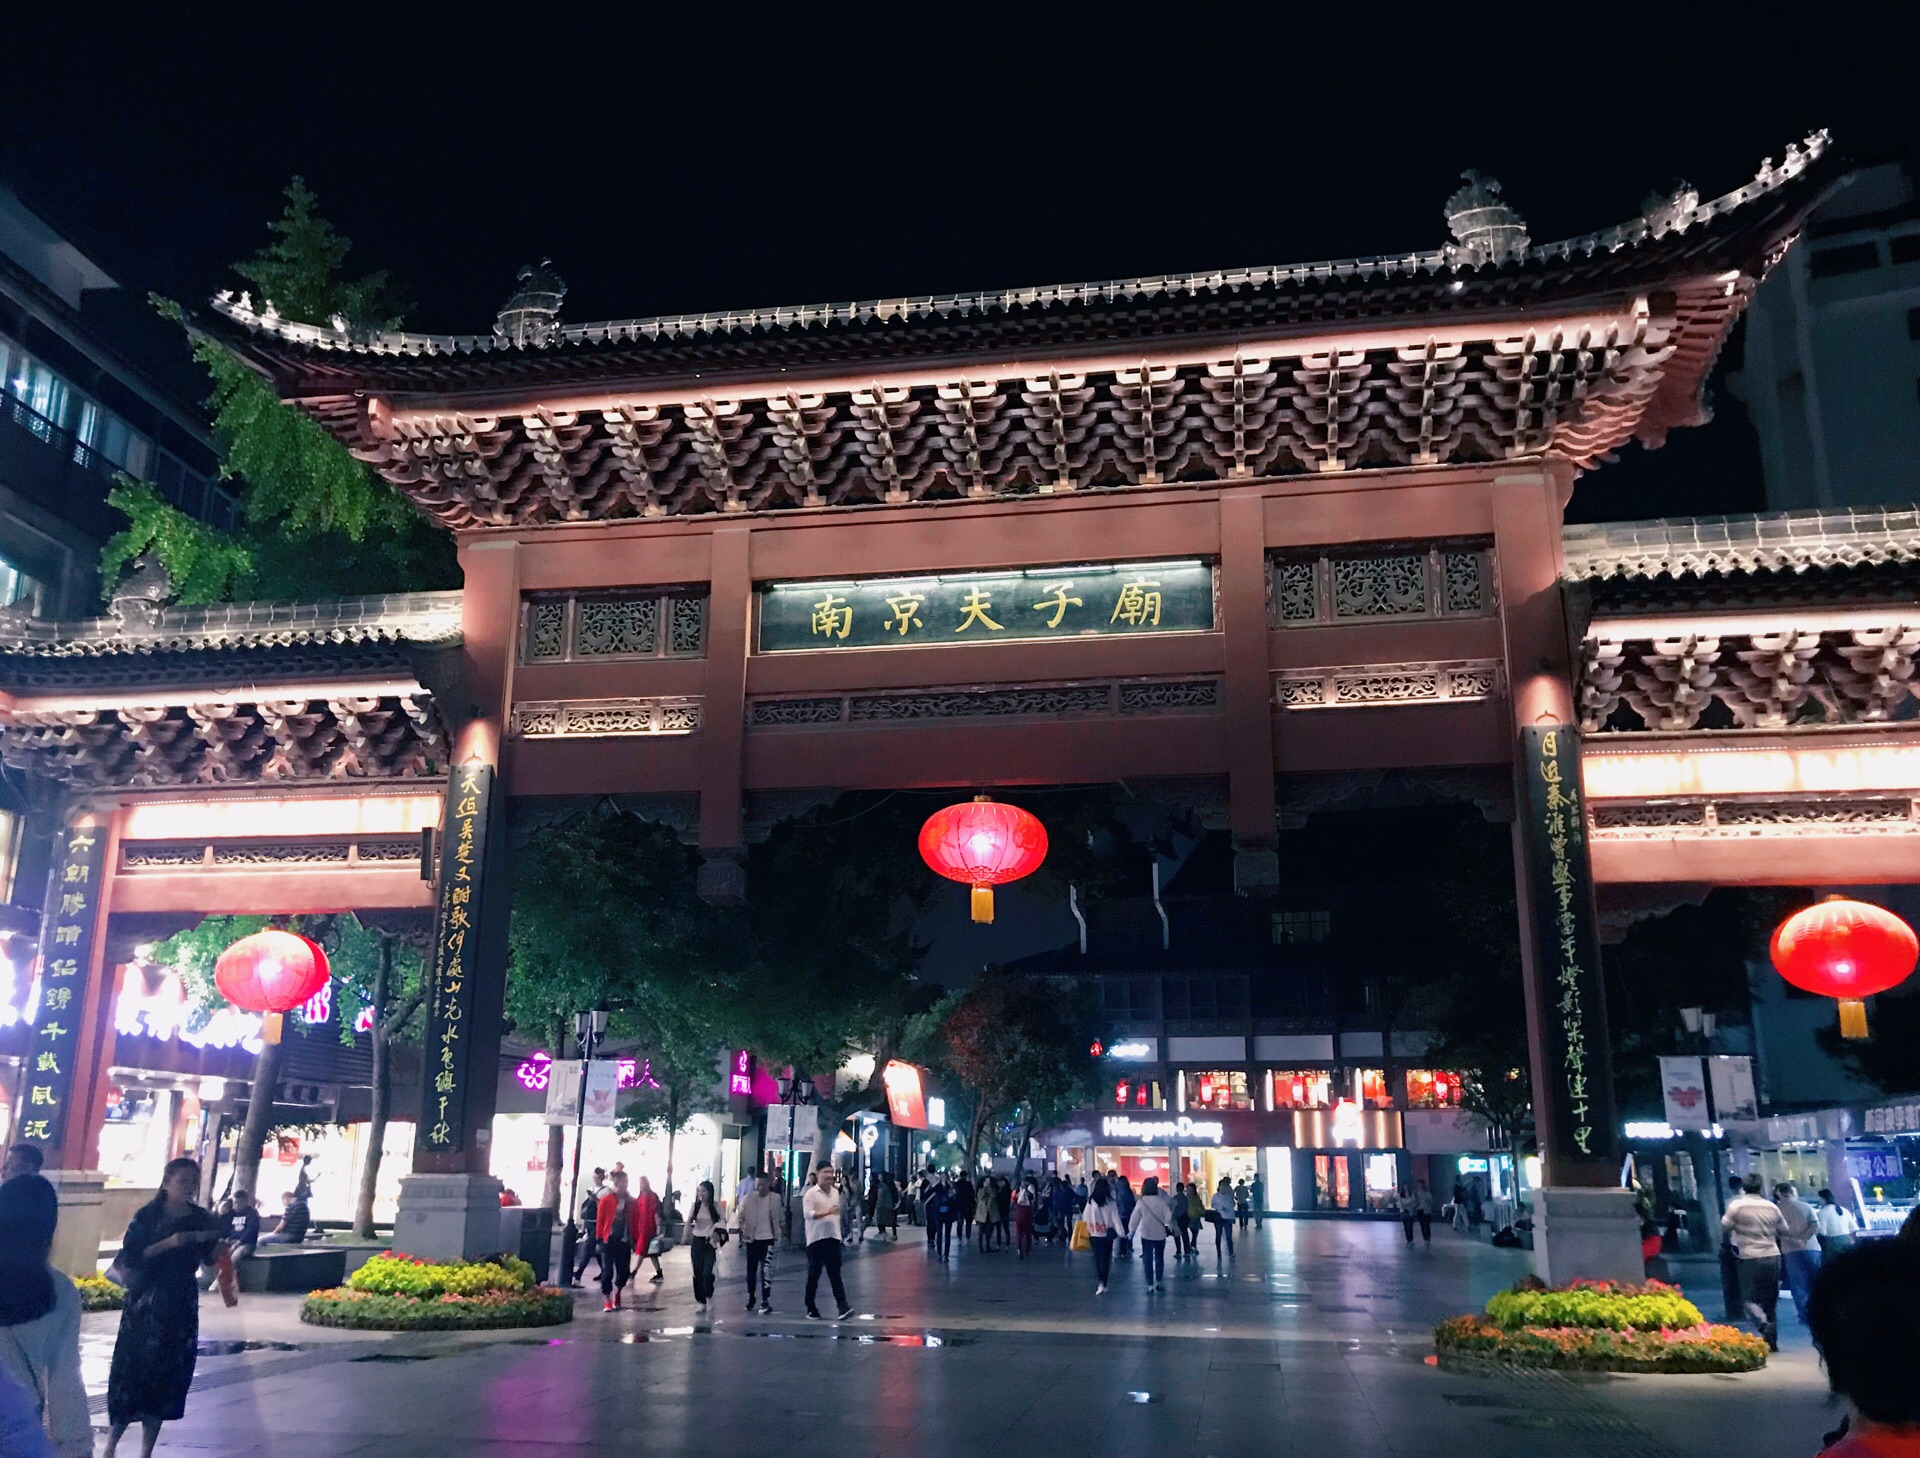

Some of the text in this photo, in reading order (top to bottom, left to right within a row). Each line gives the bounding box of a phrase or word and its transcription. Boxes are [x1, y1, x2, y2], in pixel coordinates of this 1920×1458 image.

[811, 576, 1161, 639] 南京夫子廟
